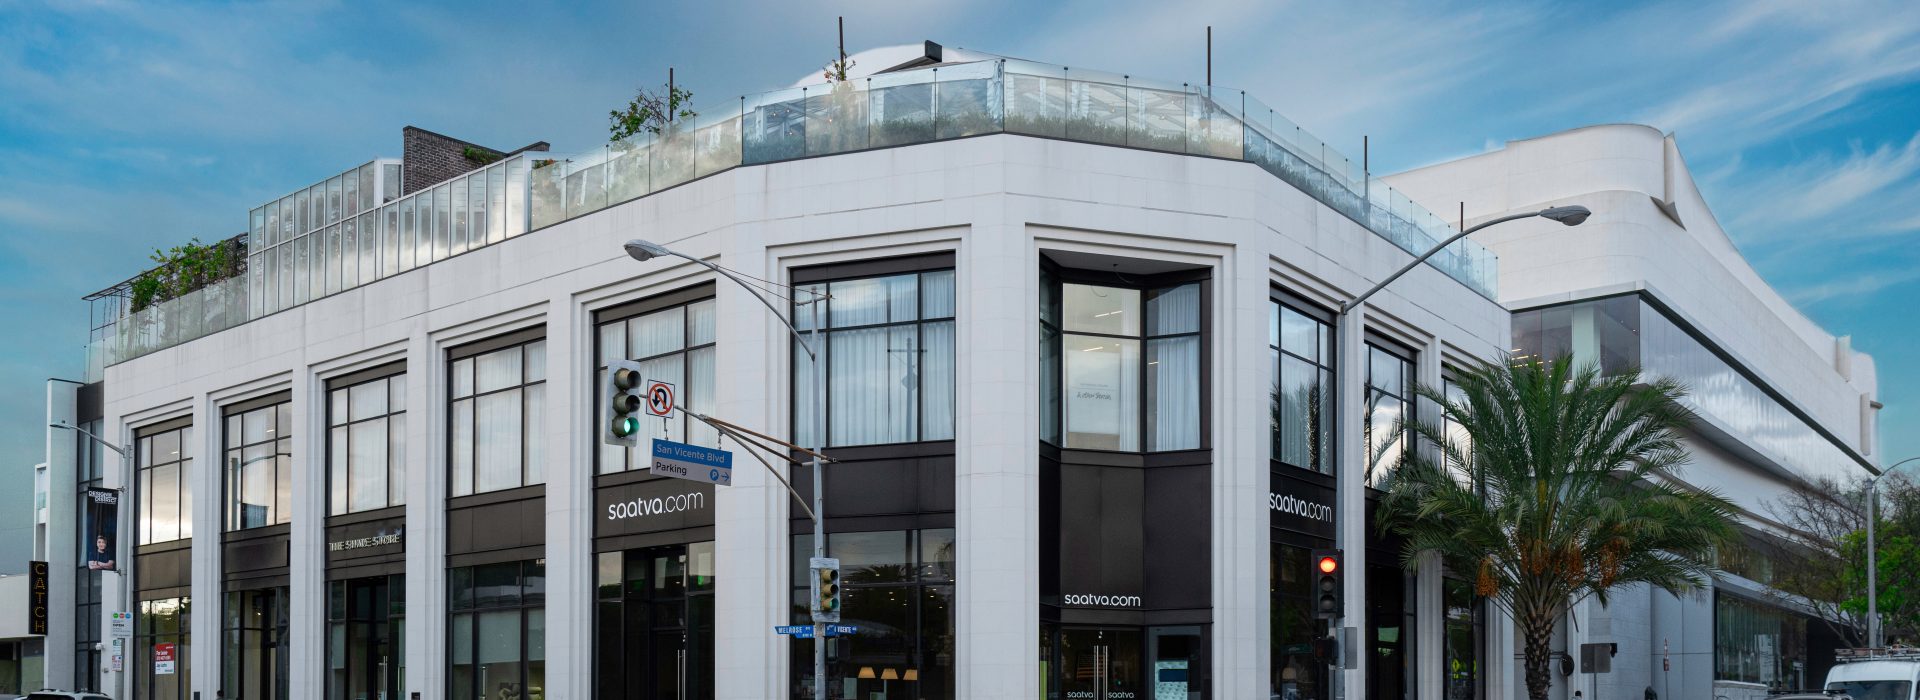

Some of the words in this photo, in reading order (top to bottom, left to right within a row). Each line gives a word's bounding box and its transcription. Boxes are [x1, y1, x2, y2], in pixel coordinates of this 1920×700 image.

[656, 444, 672, 454] San
[674, 447, 705, 460] Vicente
[707, 453, 725, 463] Blvd
[656, 461, 687, 476] Parking
[608, 492, 704, 520] saatva.com
[1270, 492, 1332, 523] saatva.com
[328, 541, 344, 551] THE
[34, 563, 46, 633] CATCH
[1064, 593, 1141, 607] saatva.com
[778, 626, 803, 634] MELROSE
[1108, 691, 1134, 699] saatva
